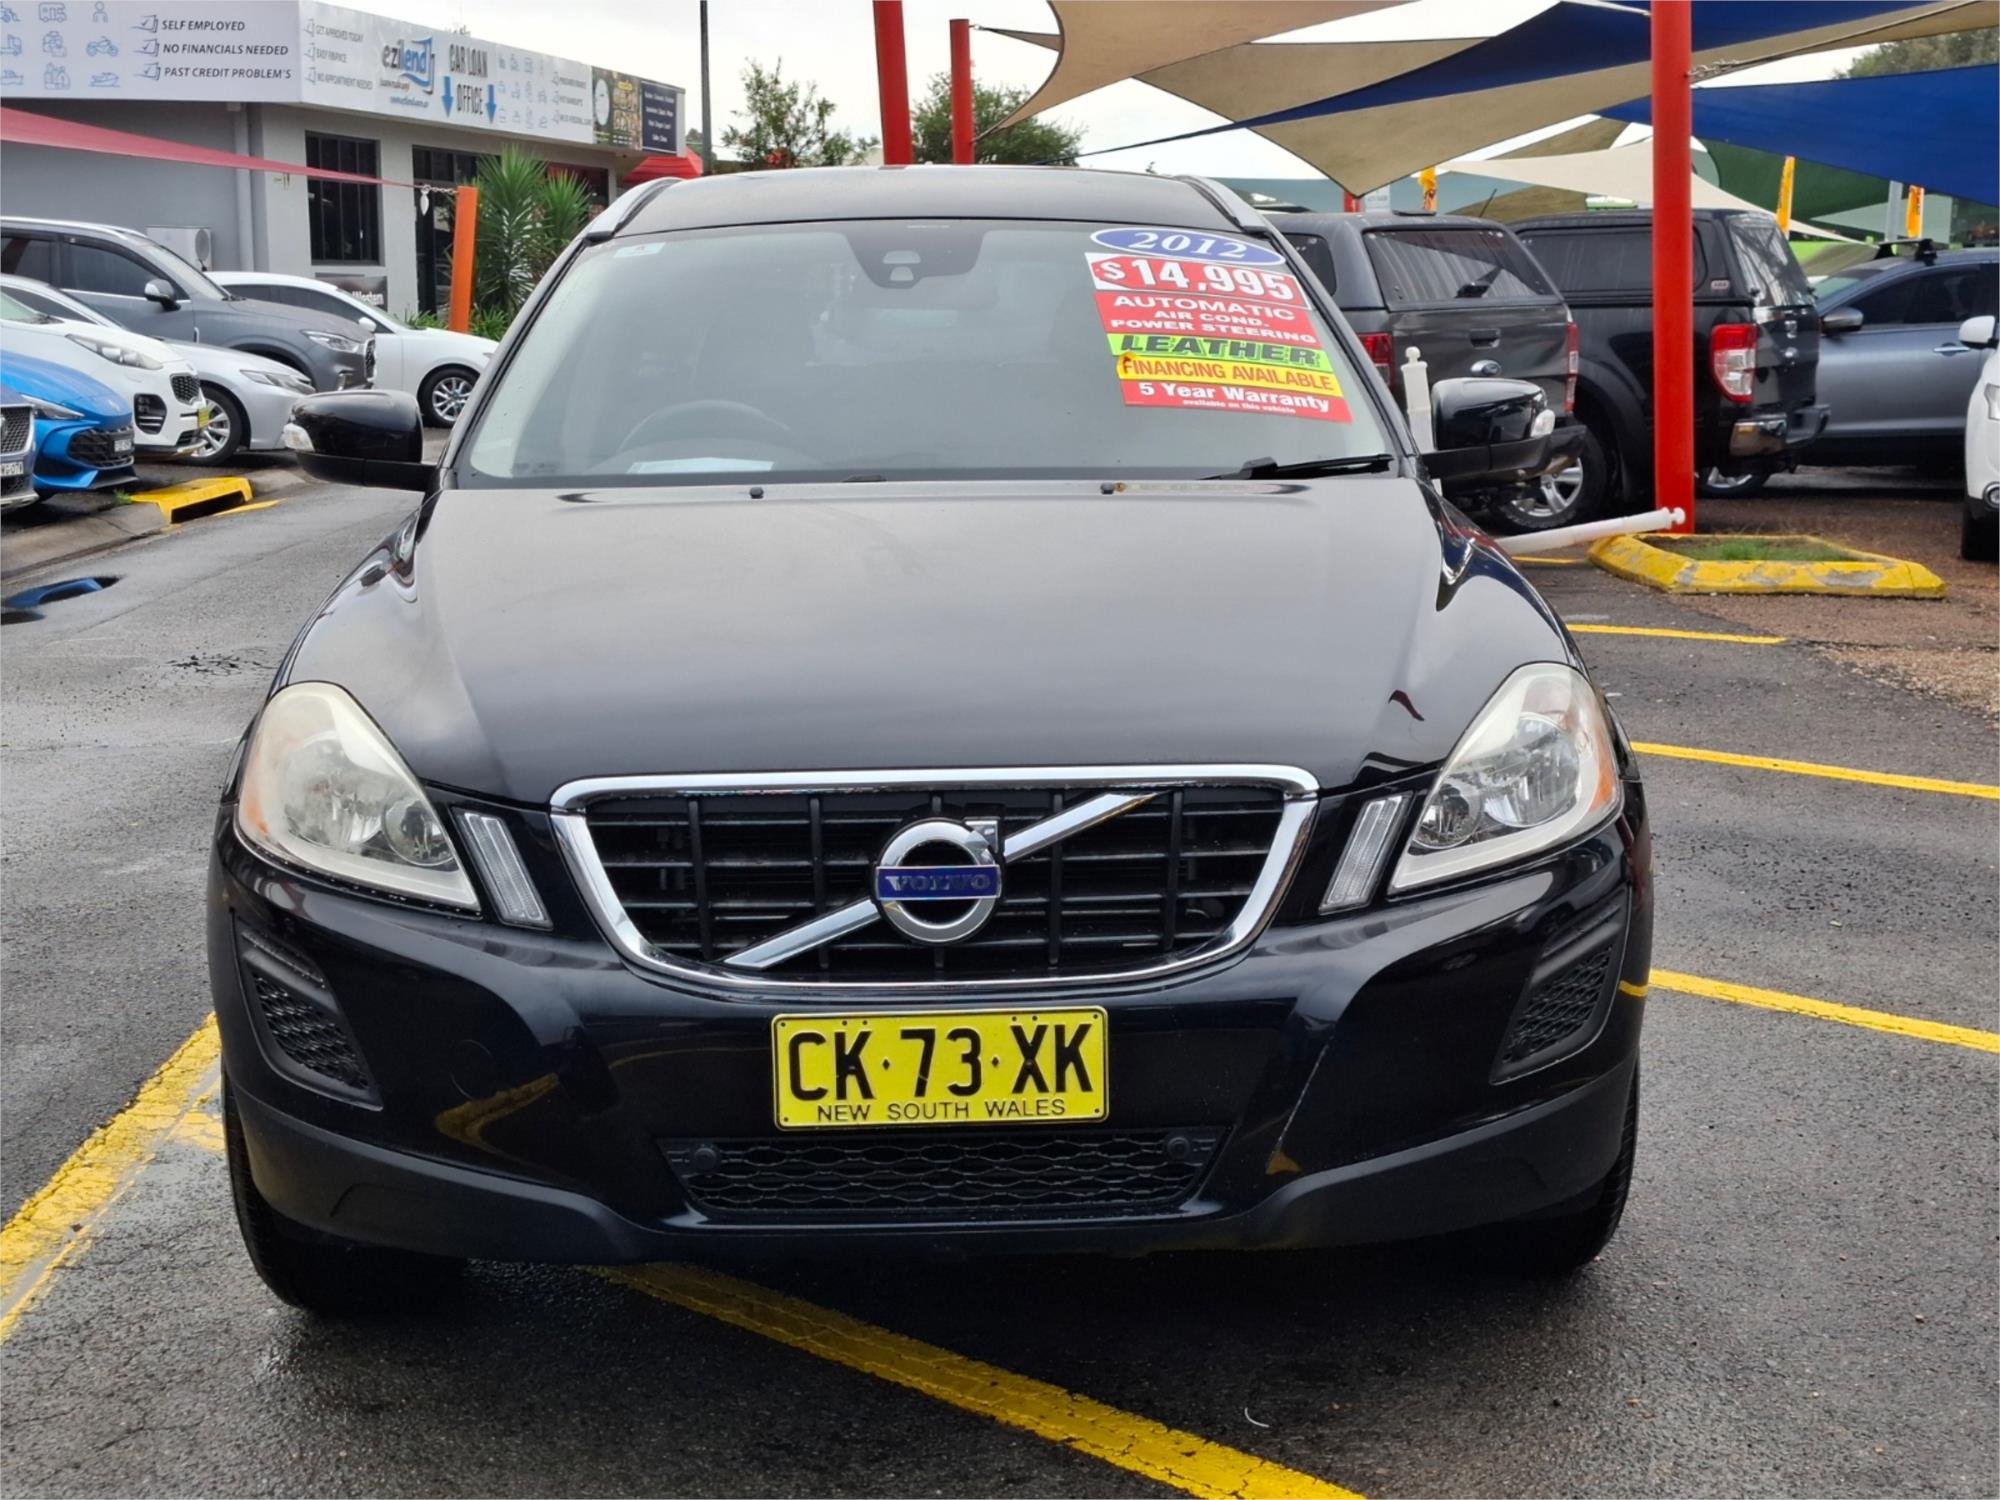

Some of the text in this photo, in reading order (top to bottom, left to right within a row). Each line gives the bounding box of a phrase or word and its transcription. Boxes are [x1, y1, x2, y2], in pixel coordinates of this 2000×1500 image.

[162, 20, 246, 31] SELF EMPLOYED
[163, 43, 288, 55] NO FINANCIALS NEEDED
[449, 44, 488, 78] CAR LOAN
[163, 67, 291, 78] PAST CREDIT PROBLEM'S
[456, 84, 484, 115] OFFICE
[1128, 231, 1248, 258] 2012
[1100, 260, 1295, 302] $14,995
[1113, 295, 1296, 320] AUTOMATIC
[1154, 309, 1269, 327] AIR COND.
[1111, 319, 1318, 343] POWER STEERING
[1119, 335, 1321, 368] LEATHER
[1122, 357, 1334, 391] FINANCING AVAILABLE
[1139, 382, 1330, 413] 5 Year Warranty
[1182, 399, 1226, 408] available
[1262, 405, 1297, 415] vehicle
[884, 875, 992, 892] VOLVO
[817, 1098, 1066, 1122] NEW SOUTH WALES
